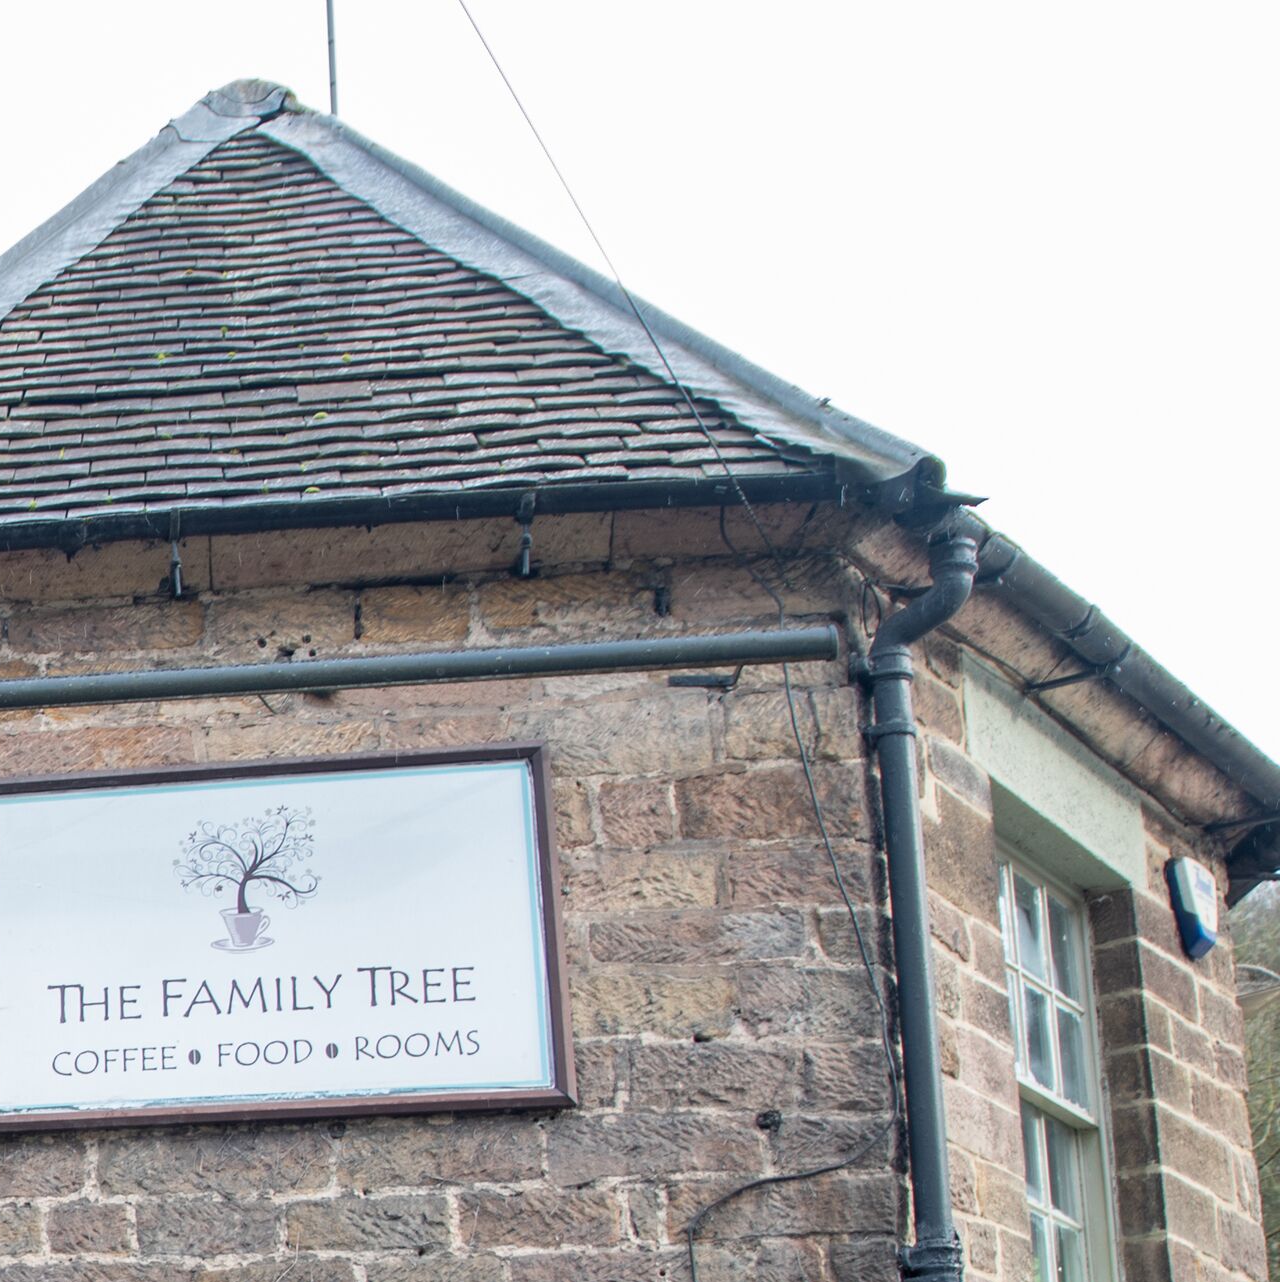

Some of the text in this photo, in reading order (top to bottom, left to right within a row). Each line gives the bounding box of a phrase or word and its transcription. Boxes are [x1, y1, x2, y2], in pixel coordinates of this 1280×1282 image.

[47, 966, 477, 1024] THE FAMILY TREE
[52, 1029, 481, 1076] COFFEE FOOD ROOMS
